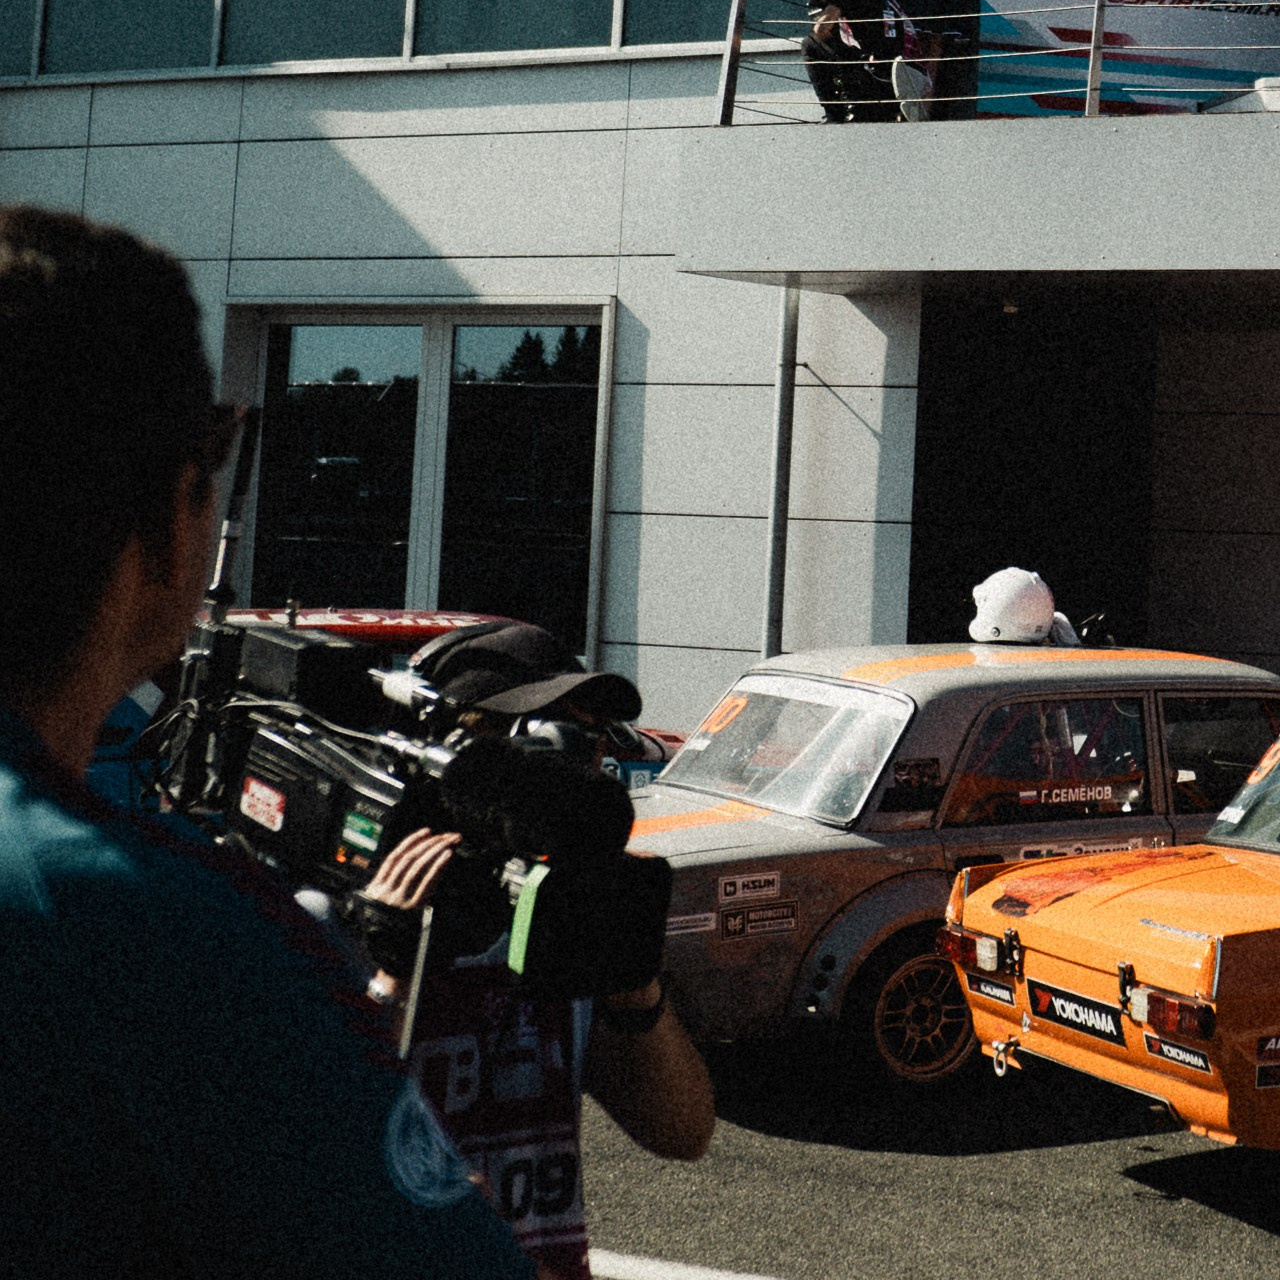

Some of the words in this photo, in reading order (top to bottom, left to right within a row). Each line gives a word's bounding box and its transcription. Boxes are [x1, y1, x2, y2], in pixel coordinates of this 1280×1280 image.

[1041, 785, 1113, 803] Г.СЕМЁНОВ
[741, 878, 775, 892] HSUN
[980, 982, 1011, 1003] YOKOHAMA
[1052, 994, 1118, 1037] YOKOHAMA
[1161, 1042, 1206, 1069] YOKOHAMA
[500, 1151, 577, 1221] 09
